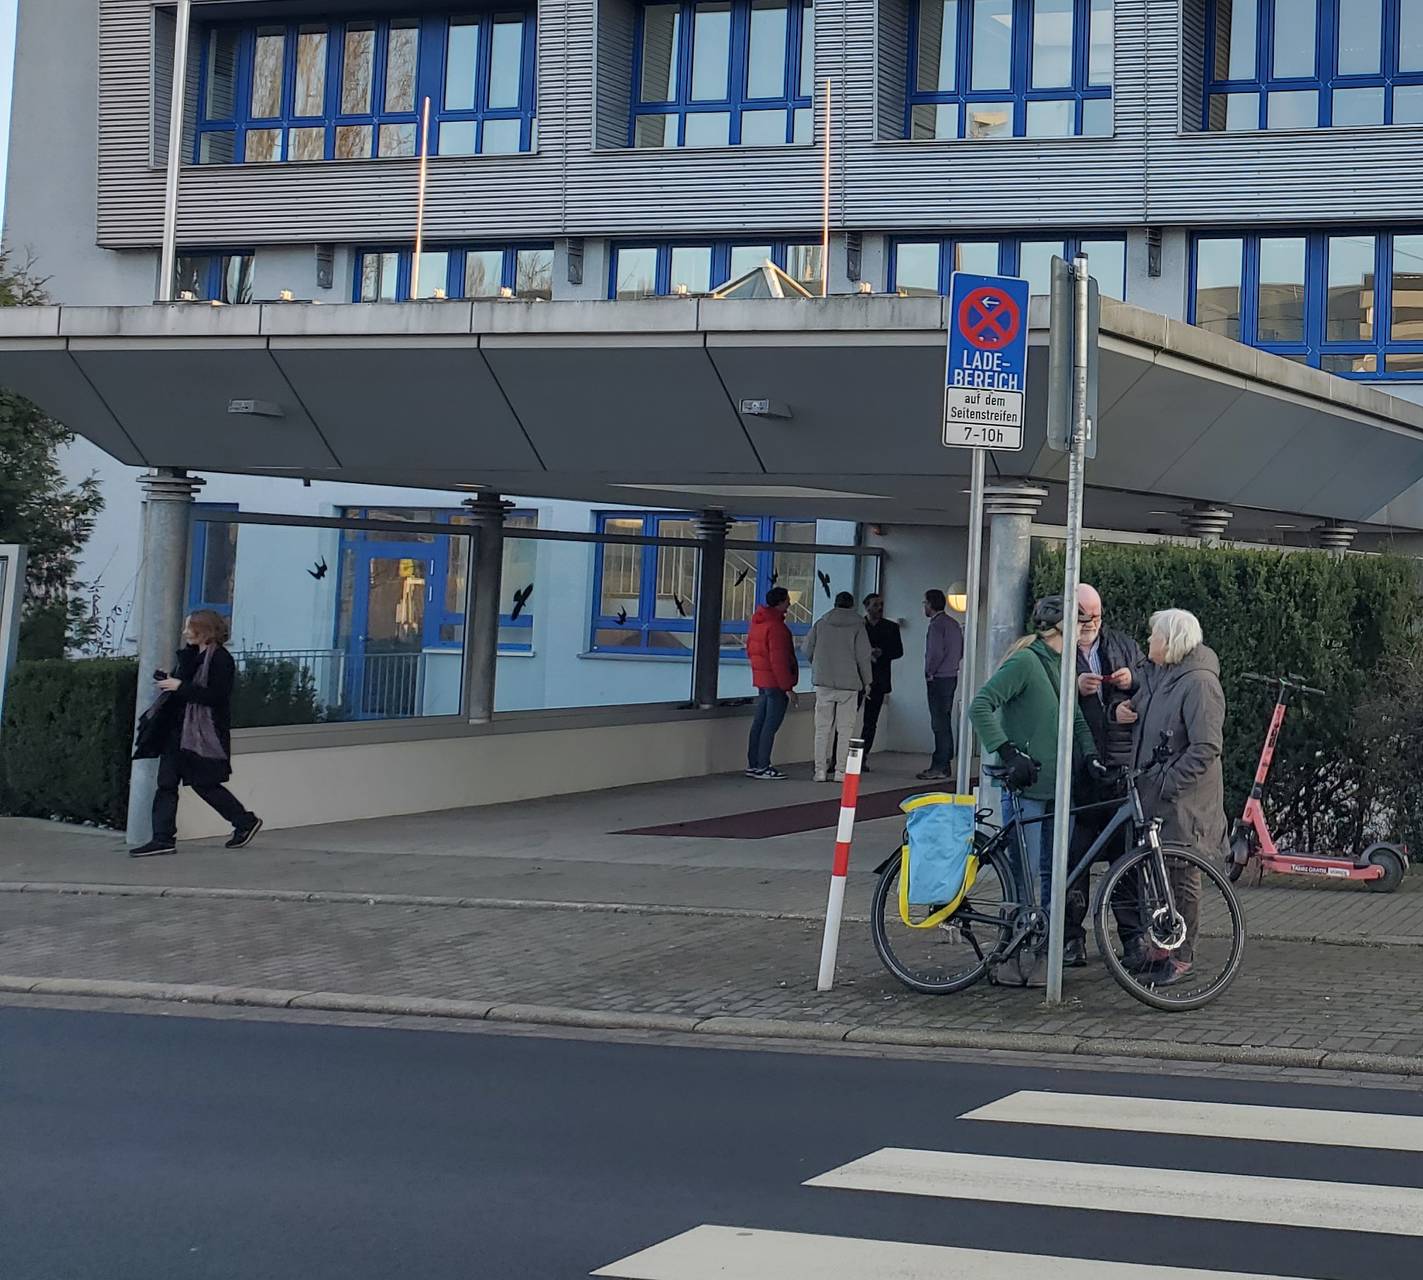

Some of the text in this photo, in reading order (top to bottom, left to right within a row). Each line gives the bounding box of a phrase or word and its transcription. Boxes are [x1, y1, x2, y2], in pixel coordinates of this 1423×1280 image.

[963, 350, 1011, 371] LADE-
[954, 369, 1018, 390] BEREICH
[964, 393, 1005, 406] auf dem
[950, 407, 1018, 423] Seitenstreifen
